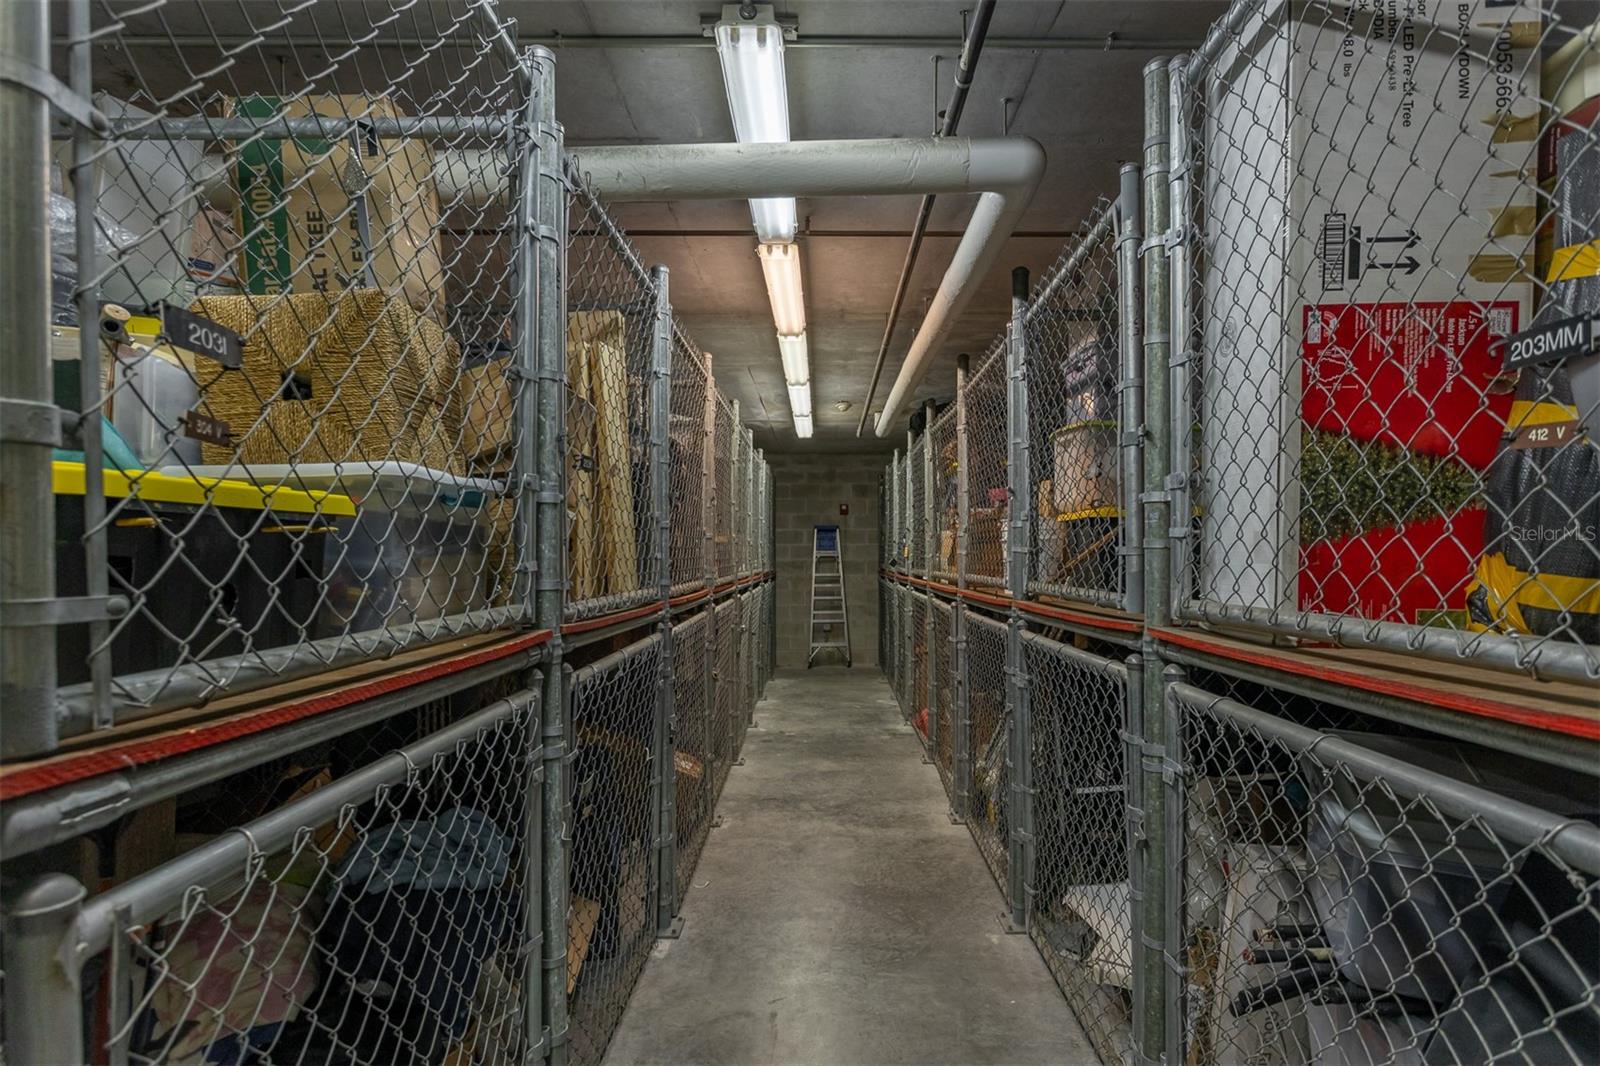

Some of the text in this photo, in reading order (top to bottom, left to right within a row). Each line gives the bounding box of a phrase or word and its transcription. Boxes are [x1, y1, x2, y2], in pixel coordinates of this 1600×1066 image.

[1403, 26, 1414, 51] LED
[1343, 63, 1353, 78] lbs
[1403, 100, 1414, 128] Tree
[1510, 322, 1584, 363] 203MM
[1528, 426, 1566, 441] 412 V
